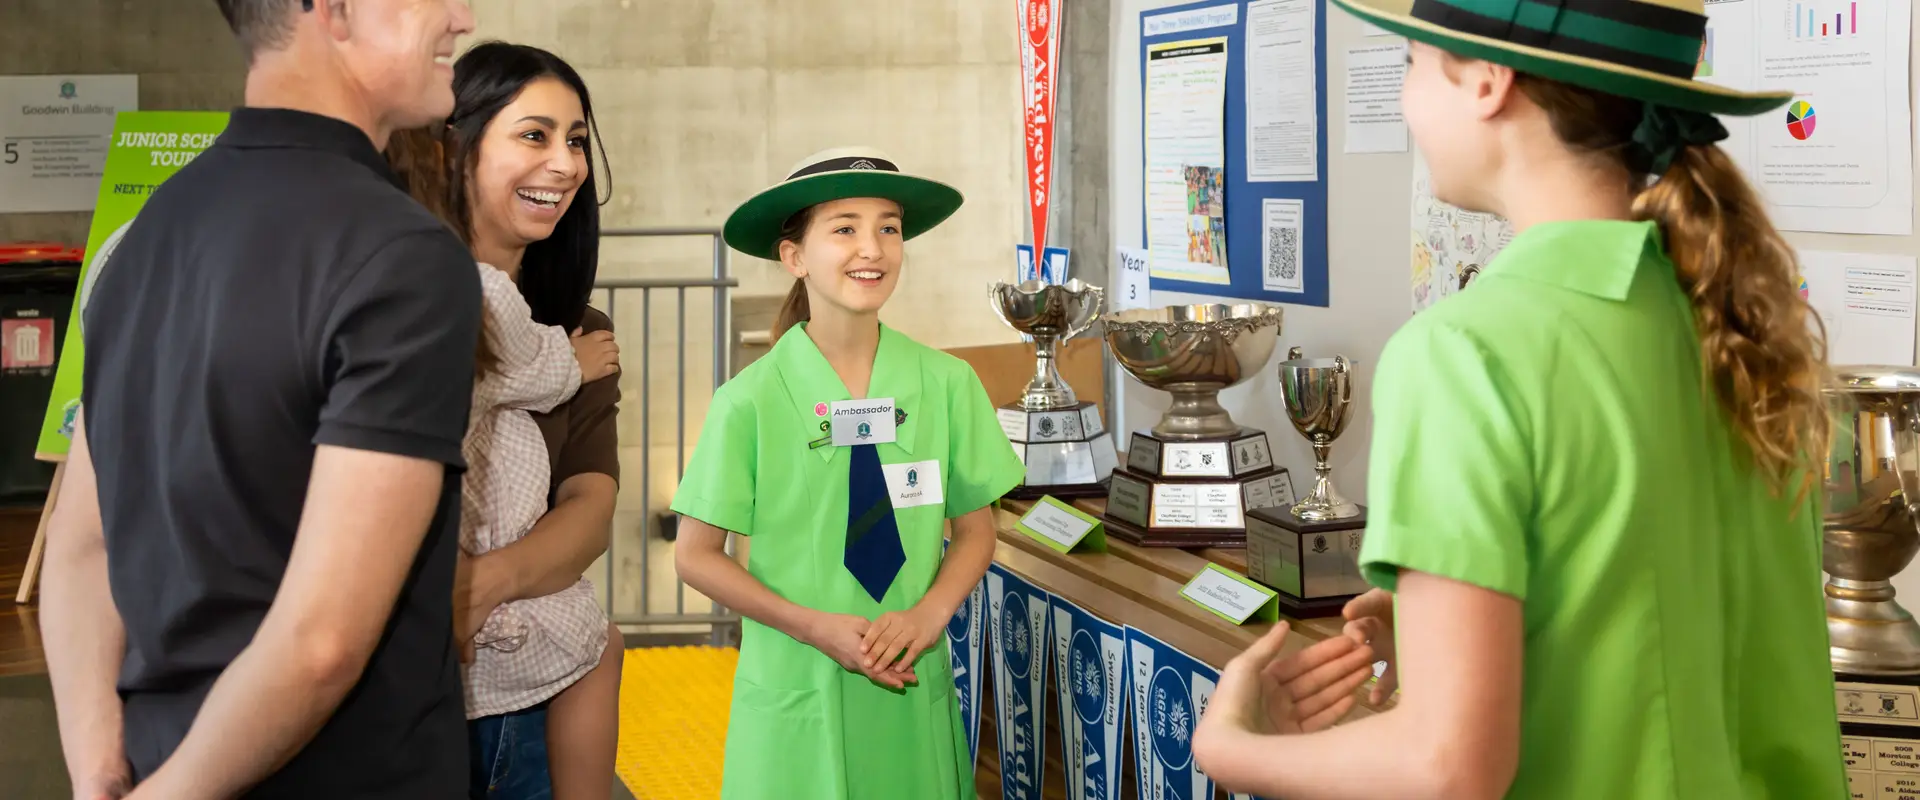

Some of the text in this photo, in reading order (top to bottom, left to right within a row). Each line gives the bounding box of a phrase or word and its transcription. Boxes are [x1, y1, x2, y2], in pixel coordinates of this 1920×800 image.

[22, 104, 114, 116] Goodwin Building
[116, 132, 179, 148] JUNIOR
[1027, 108, 1035, 147] CUP
[1033, 52, 1048, 207] Andrews
[4, 142, 19, 164] 5
[113, 184, 145, 194] NEXT
[1120, 252, 1145, 272] Year
[1129, 284, 1136, 300] 3
[16, 309, 39, 317] waste
[833, 405, 892, 417] Ambassador
[972, 585, 981, 649] Swimming
[992, 617, 1000, 655] years
[1032, 611, 1041, 682] Swimming
[1058, 651, 1067, 695] years
[1075, 649, 1084, 695] QGPIS
[962, 684, 970, 715] THE
[1106, 649, 1116, 726] Swimming
[1157, 687, 1166, 738] QGPIS
[1136, 660, 1150, 800] 12 years and over
[1852, 751, 1867, 759] Bay
[1878, 751, 1911, 760] Moreton
[1890, 760, 1920, 769] College
